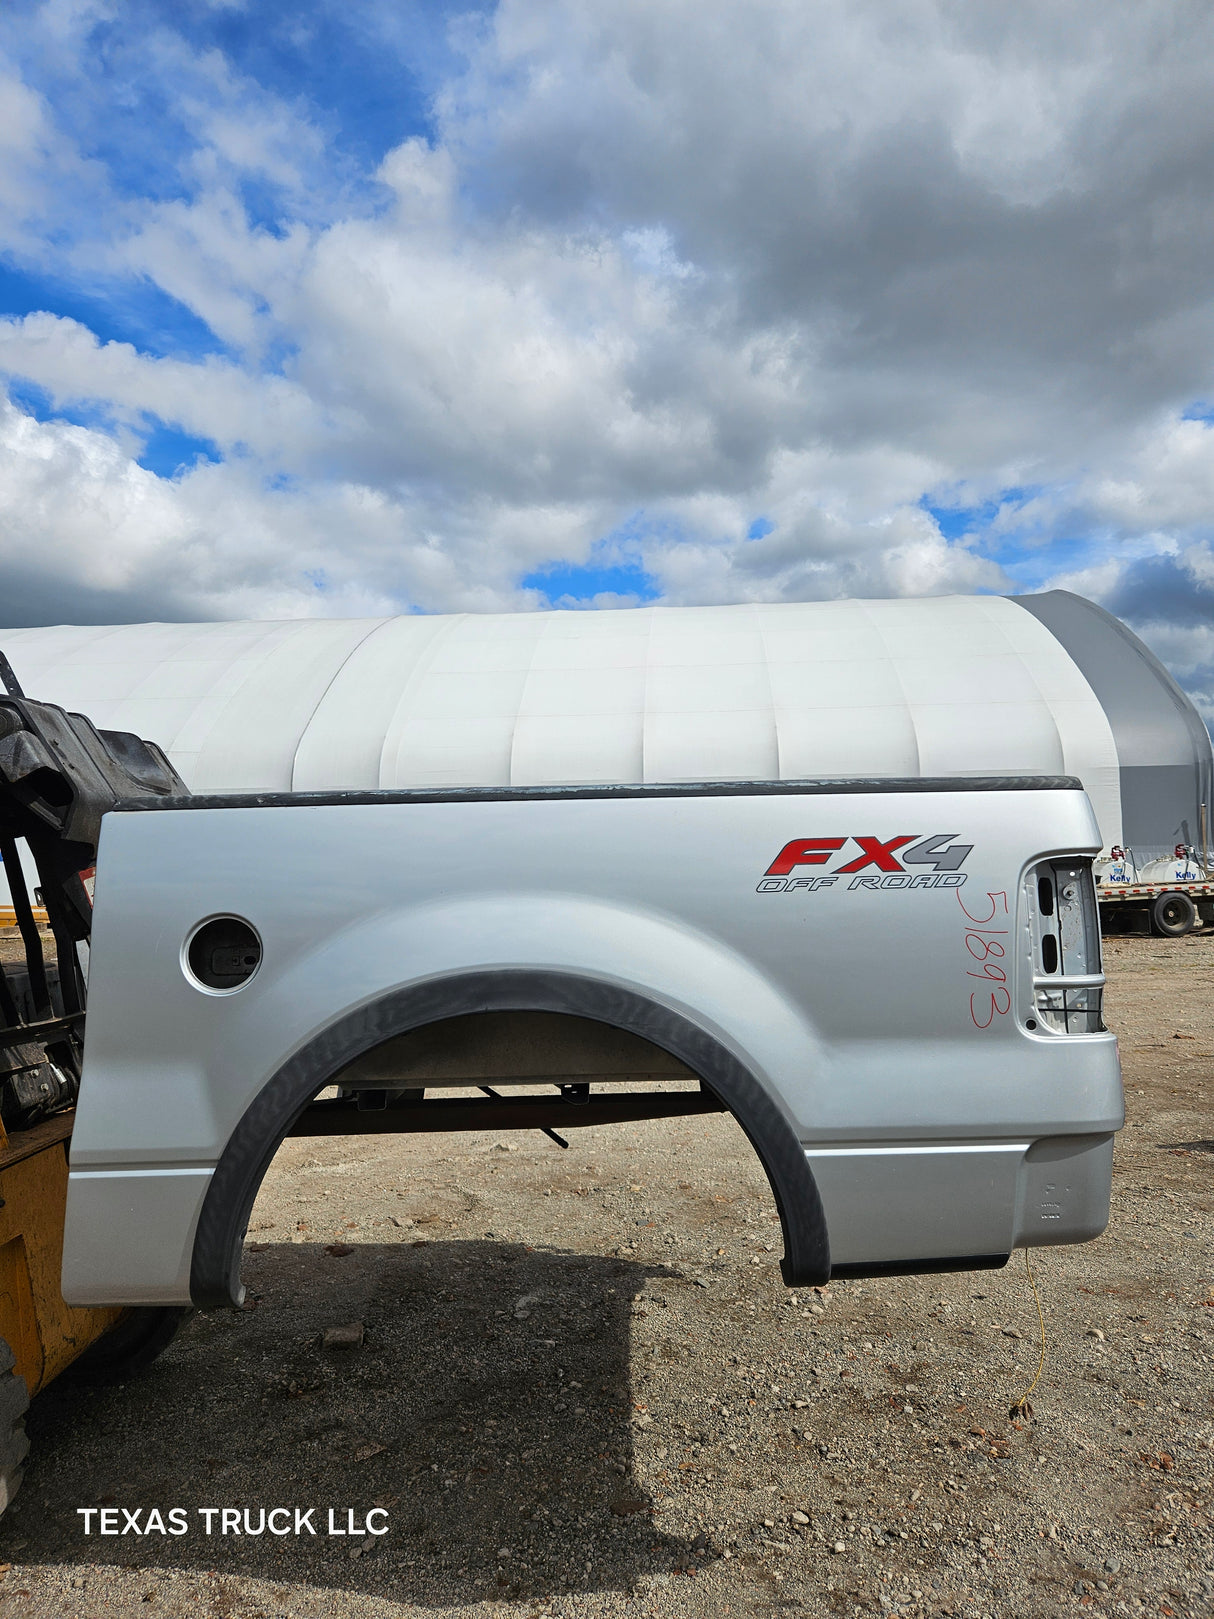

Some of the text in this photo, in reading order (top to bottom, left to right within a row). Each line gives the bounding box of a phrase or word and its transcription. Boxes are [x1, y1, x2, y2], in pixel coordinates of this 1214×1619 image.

[763, 833, 975, 876] FX4
[755, 873, 969, 894] OFF ROAD
[1109, 874, 1131, 883] Kelly
[1175, 870, 1197, 880] Kelly
[956, 887, 1011, 1029] 51893
